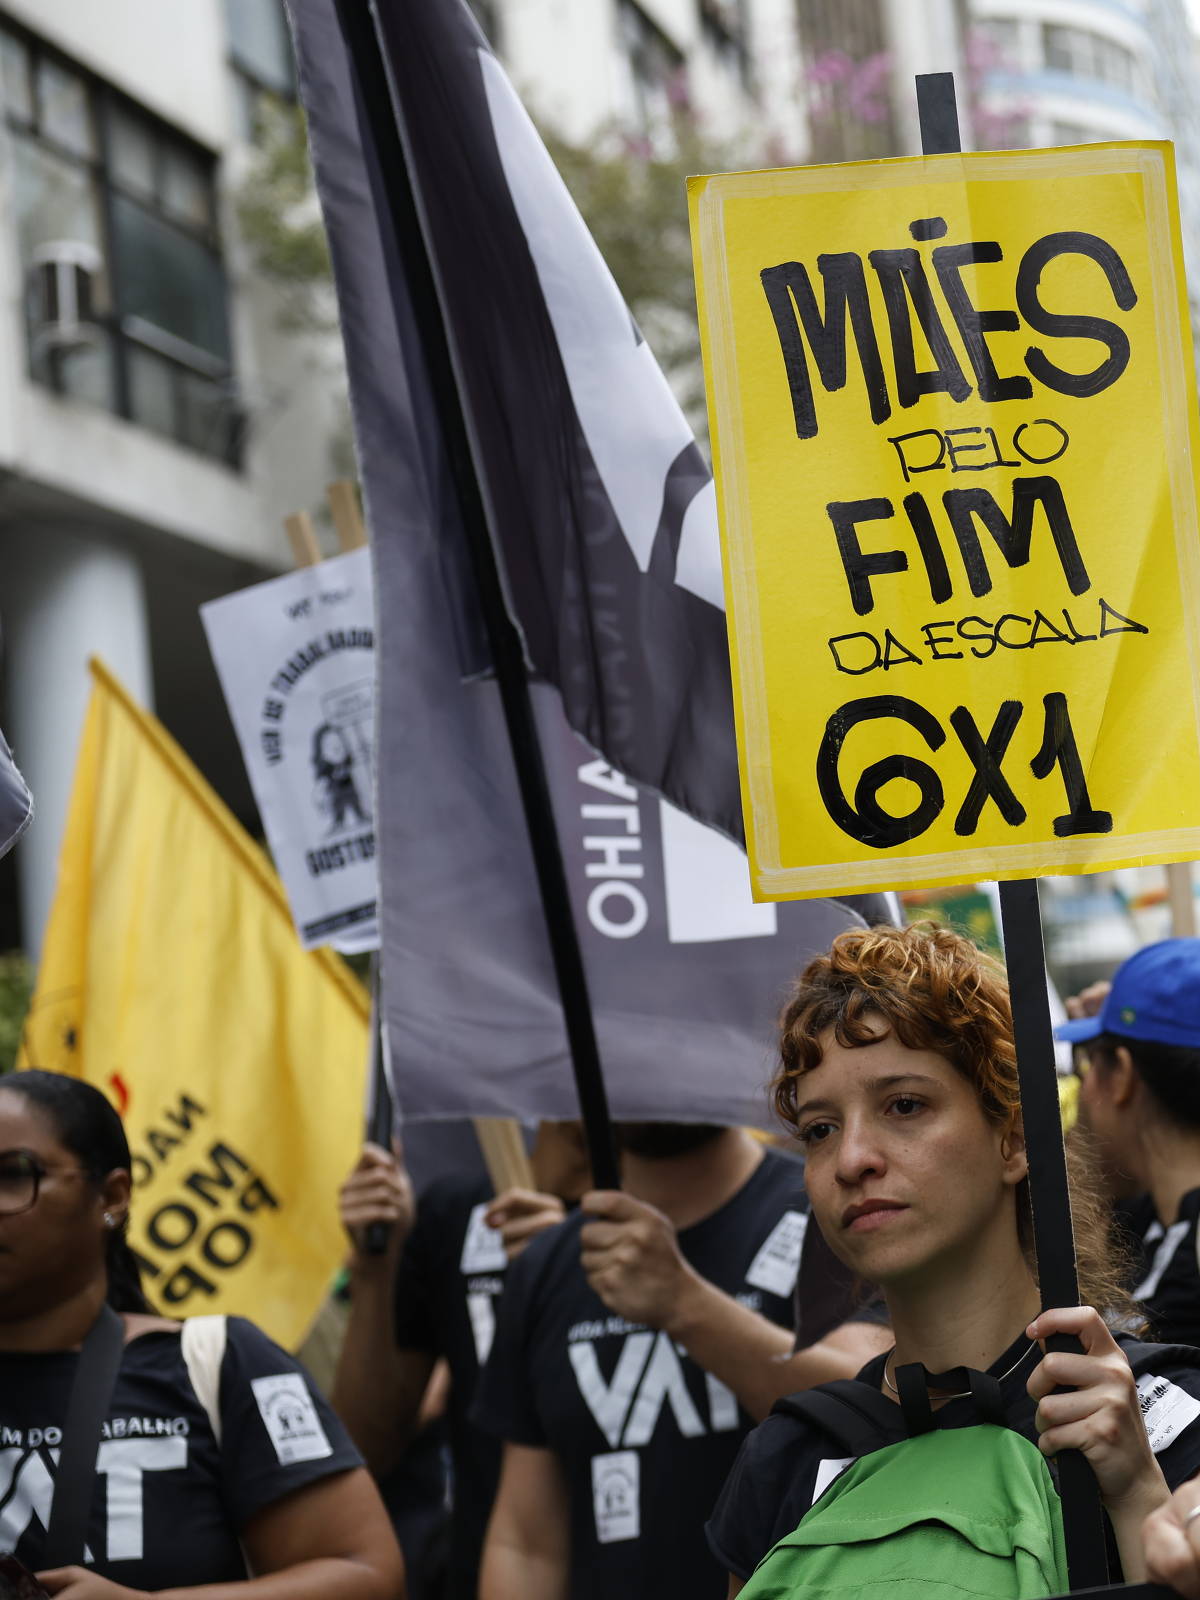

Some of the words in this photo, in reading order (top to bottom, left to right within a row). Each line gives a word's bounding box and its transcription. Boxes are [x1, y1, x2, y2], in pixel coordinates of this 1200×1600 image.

[888, 419, 1070, 482] PELO
[826, 475, 1091, 616] FIM
[828, 629, 924, 675] DA
[923, 599, 1149, 661] ESCALA
[817, 691, 1113, 849] 6X1
[28, 1426, 63, 1448] DO
[102, 1417, 189, 1439] ABALHO
